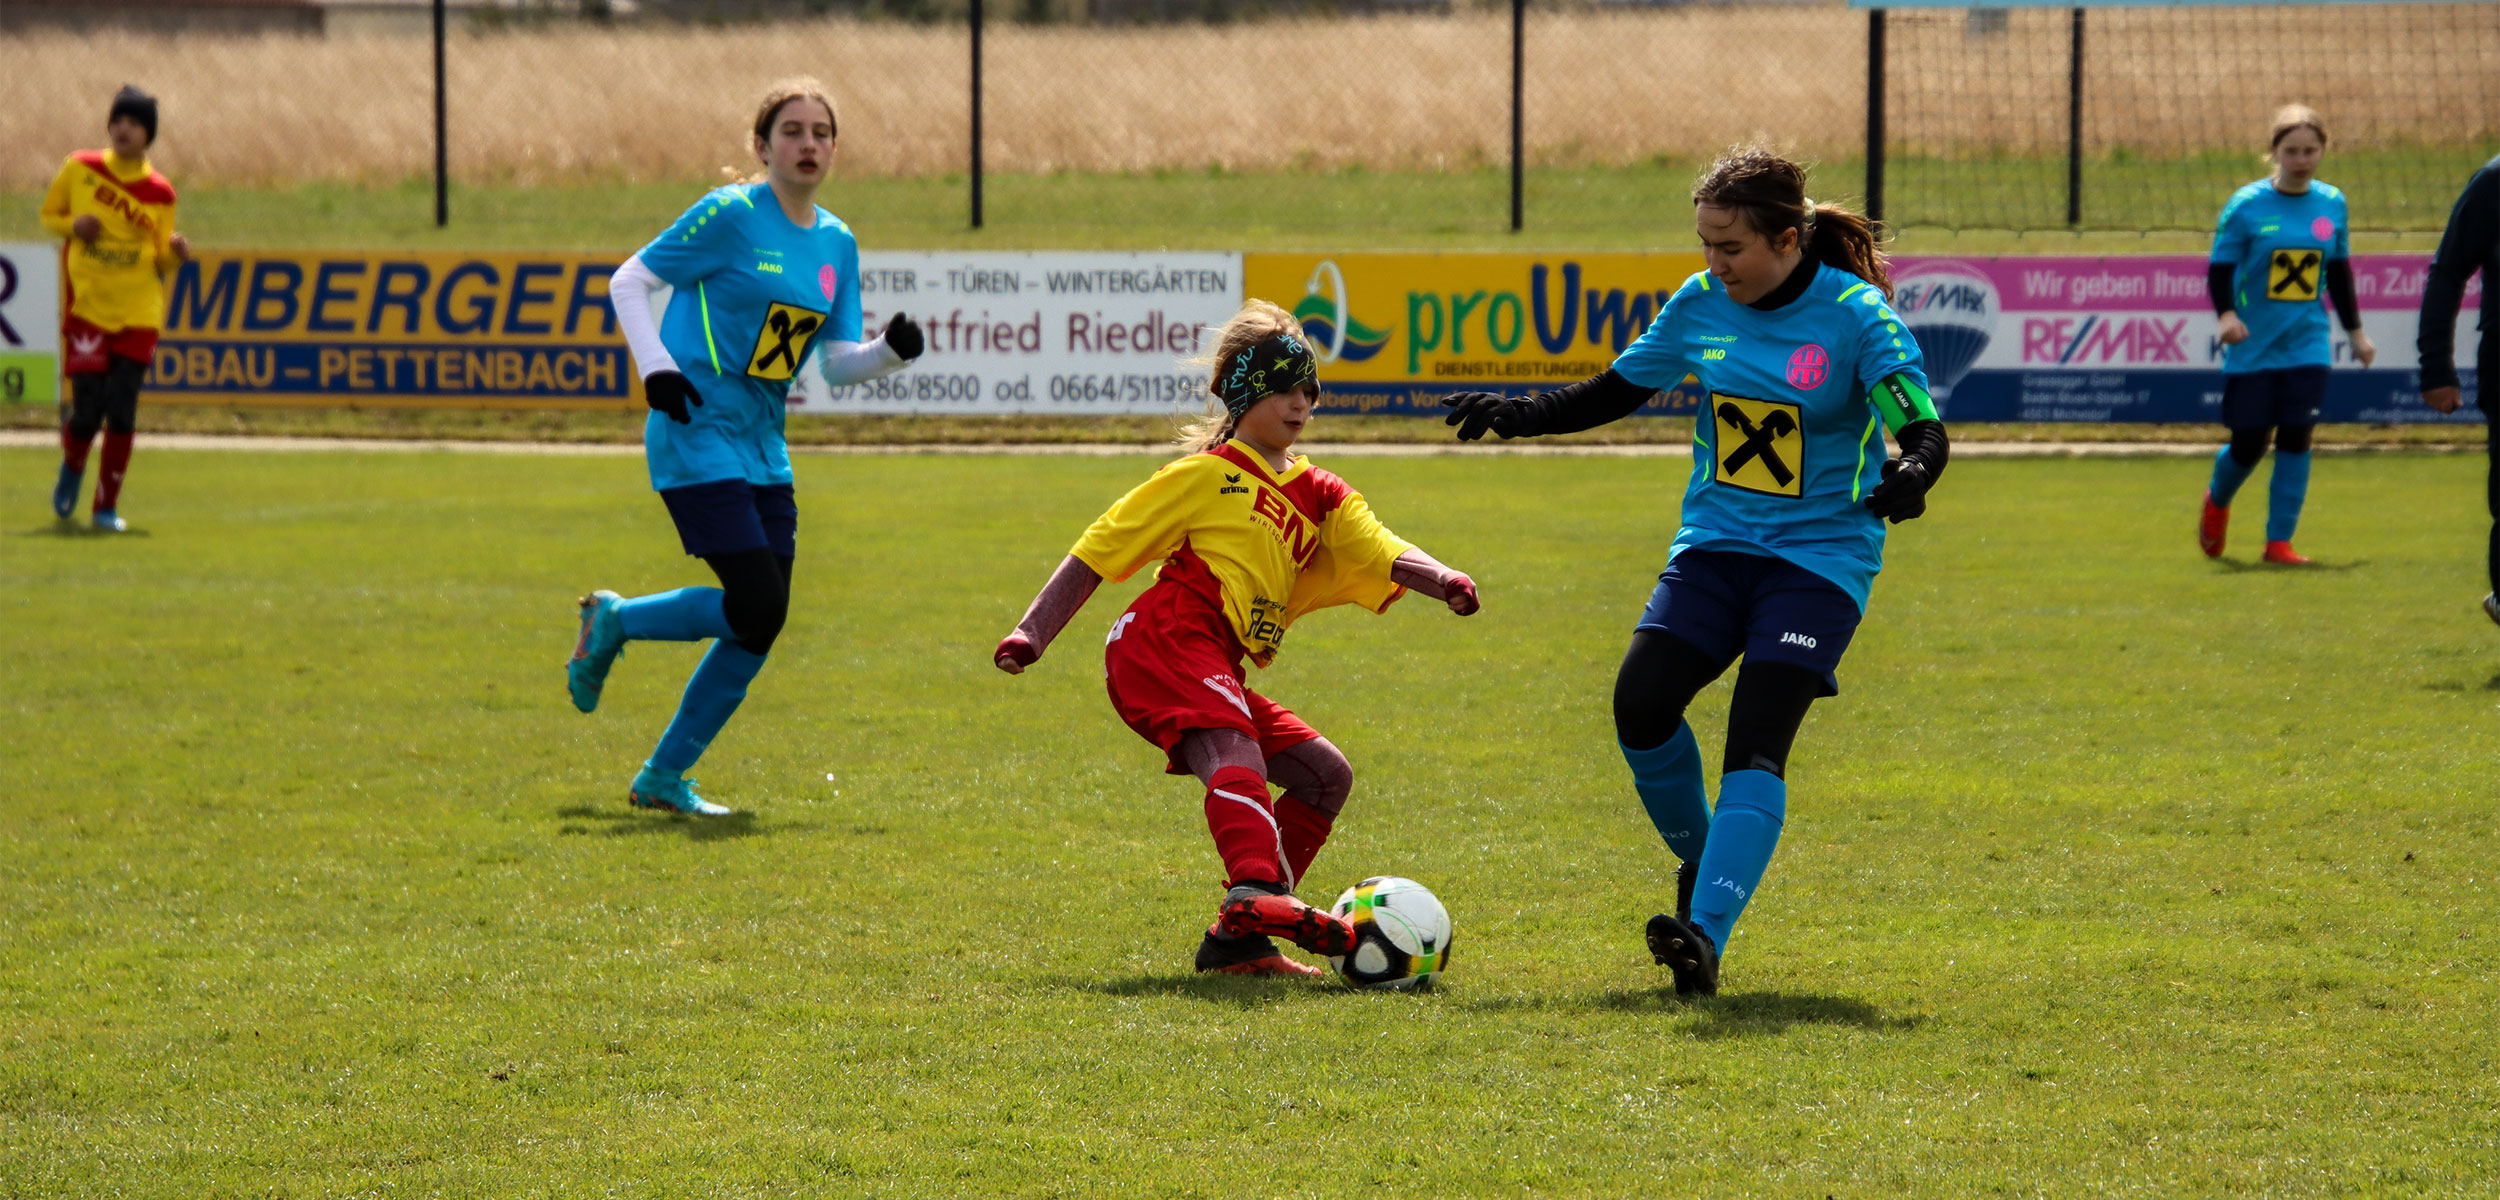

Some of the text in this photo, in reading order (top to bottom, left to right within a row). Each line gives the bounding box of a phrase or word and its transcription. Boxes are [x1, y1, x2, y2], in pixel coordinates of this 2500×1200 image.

[757, 261, 783, 274] JAKO
[947, 265, 1020, 293] TÜREN
[1047, 264, 1227, 293] WINTERGÄRTEN
[166, 261, 617, 334] MBERGER
[2023, 269, 2062, 298] Wir
[2071, 269, 2147, 305] geben
[1069, 312, 1206, 353] Riedler
[1702, 348, 1726, 360] JAKO
[149, 347, 276, 387] DBAU
[319, 349, 617, 391] PETTENBACH
[995, 374, 1036, 402] od.
[1895, 391, 1910, 408] JAKO
[1220, 484, 1249, 495] erima
[1781, 631, 1817, 649] JAKO
[1660, 830, 1690, 840] AKO
[1711, 876, 1746, 900] JAKO
